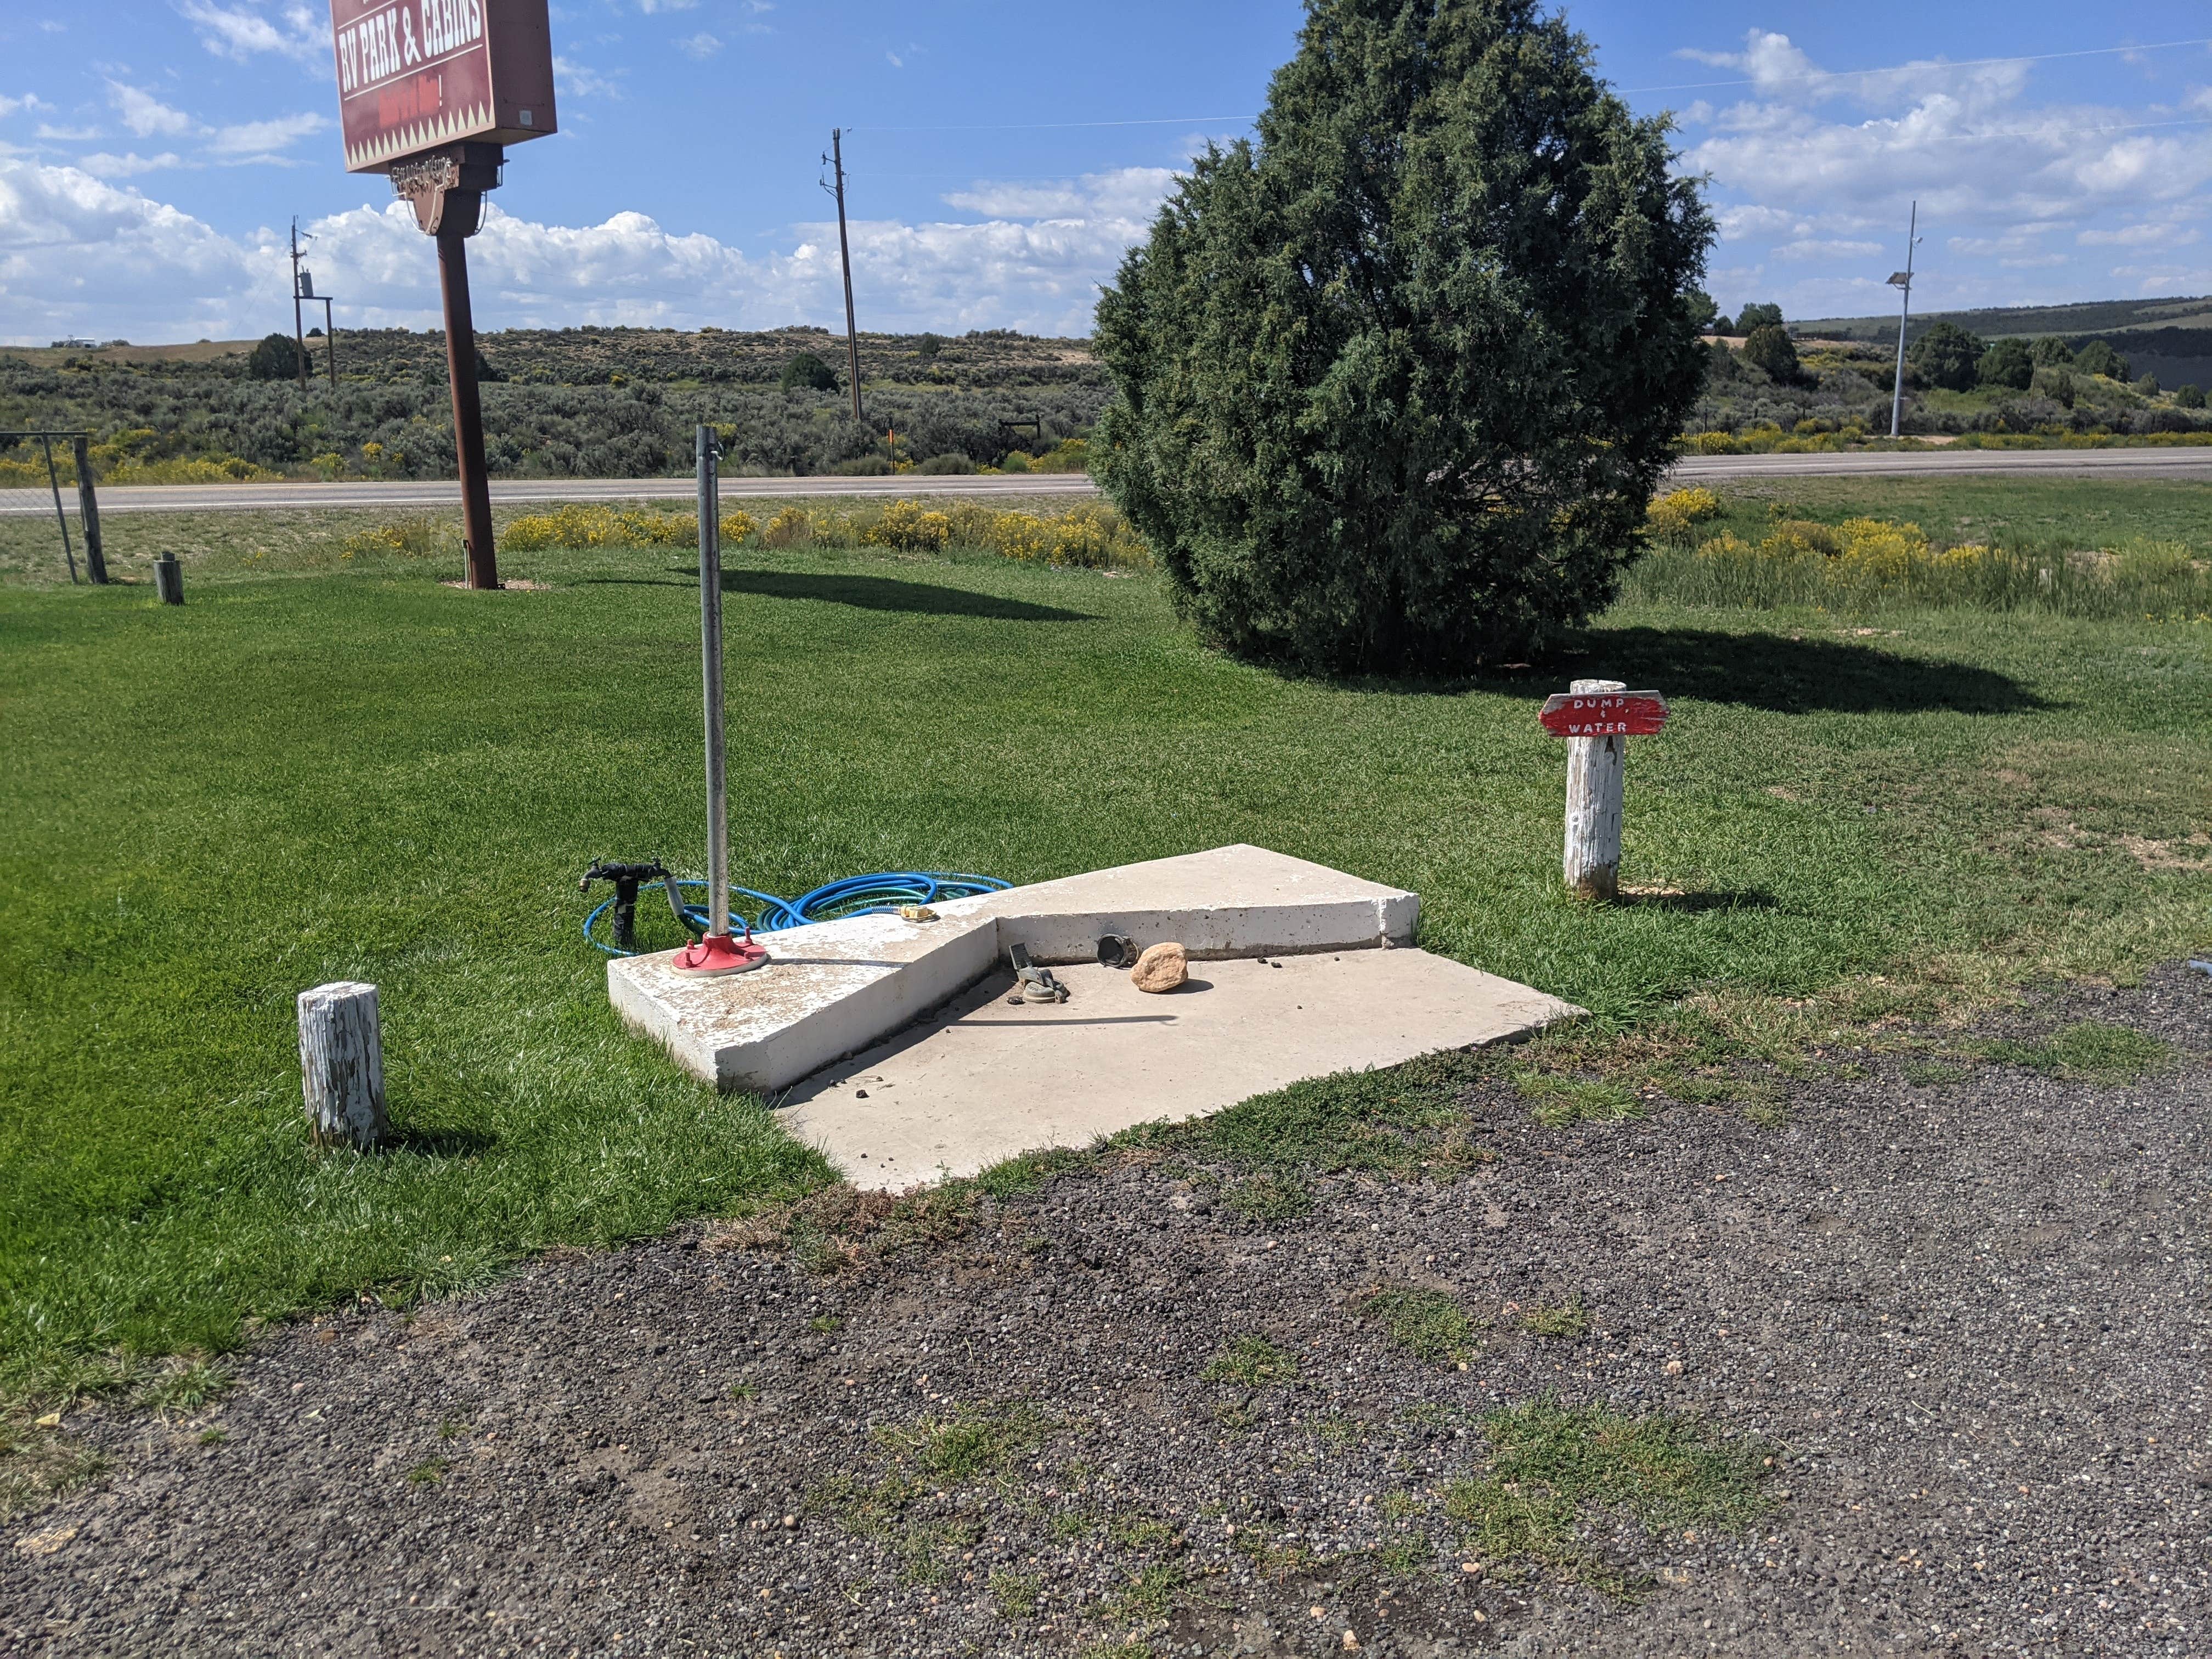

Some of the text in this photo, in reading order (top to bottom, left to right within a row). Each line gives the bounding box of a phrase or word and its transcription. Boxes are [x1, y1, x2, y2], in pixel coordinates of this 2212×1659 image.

[338, 0, 481, 93] RV PARK & CABINS
[1568, 722, 1627, 733] WATER
